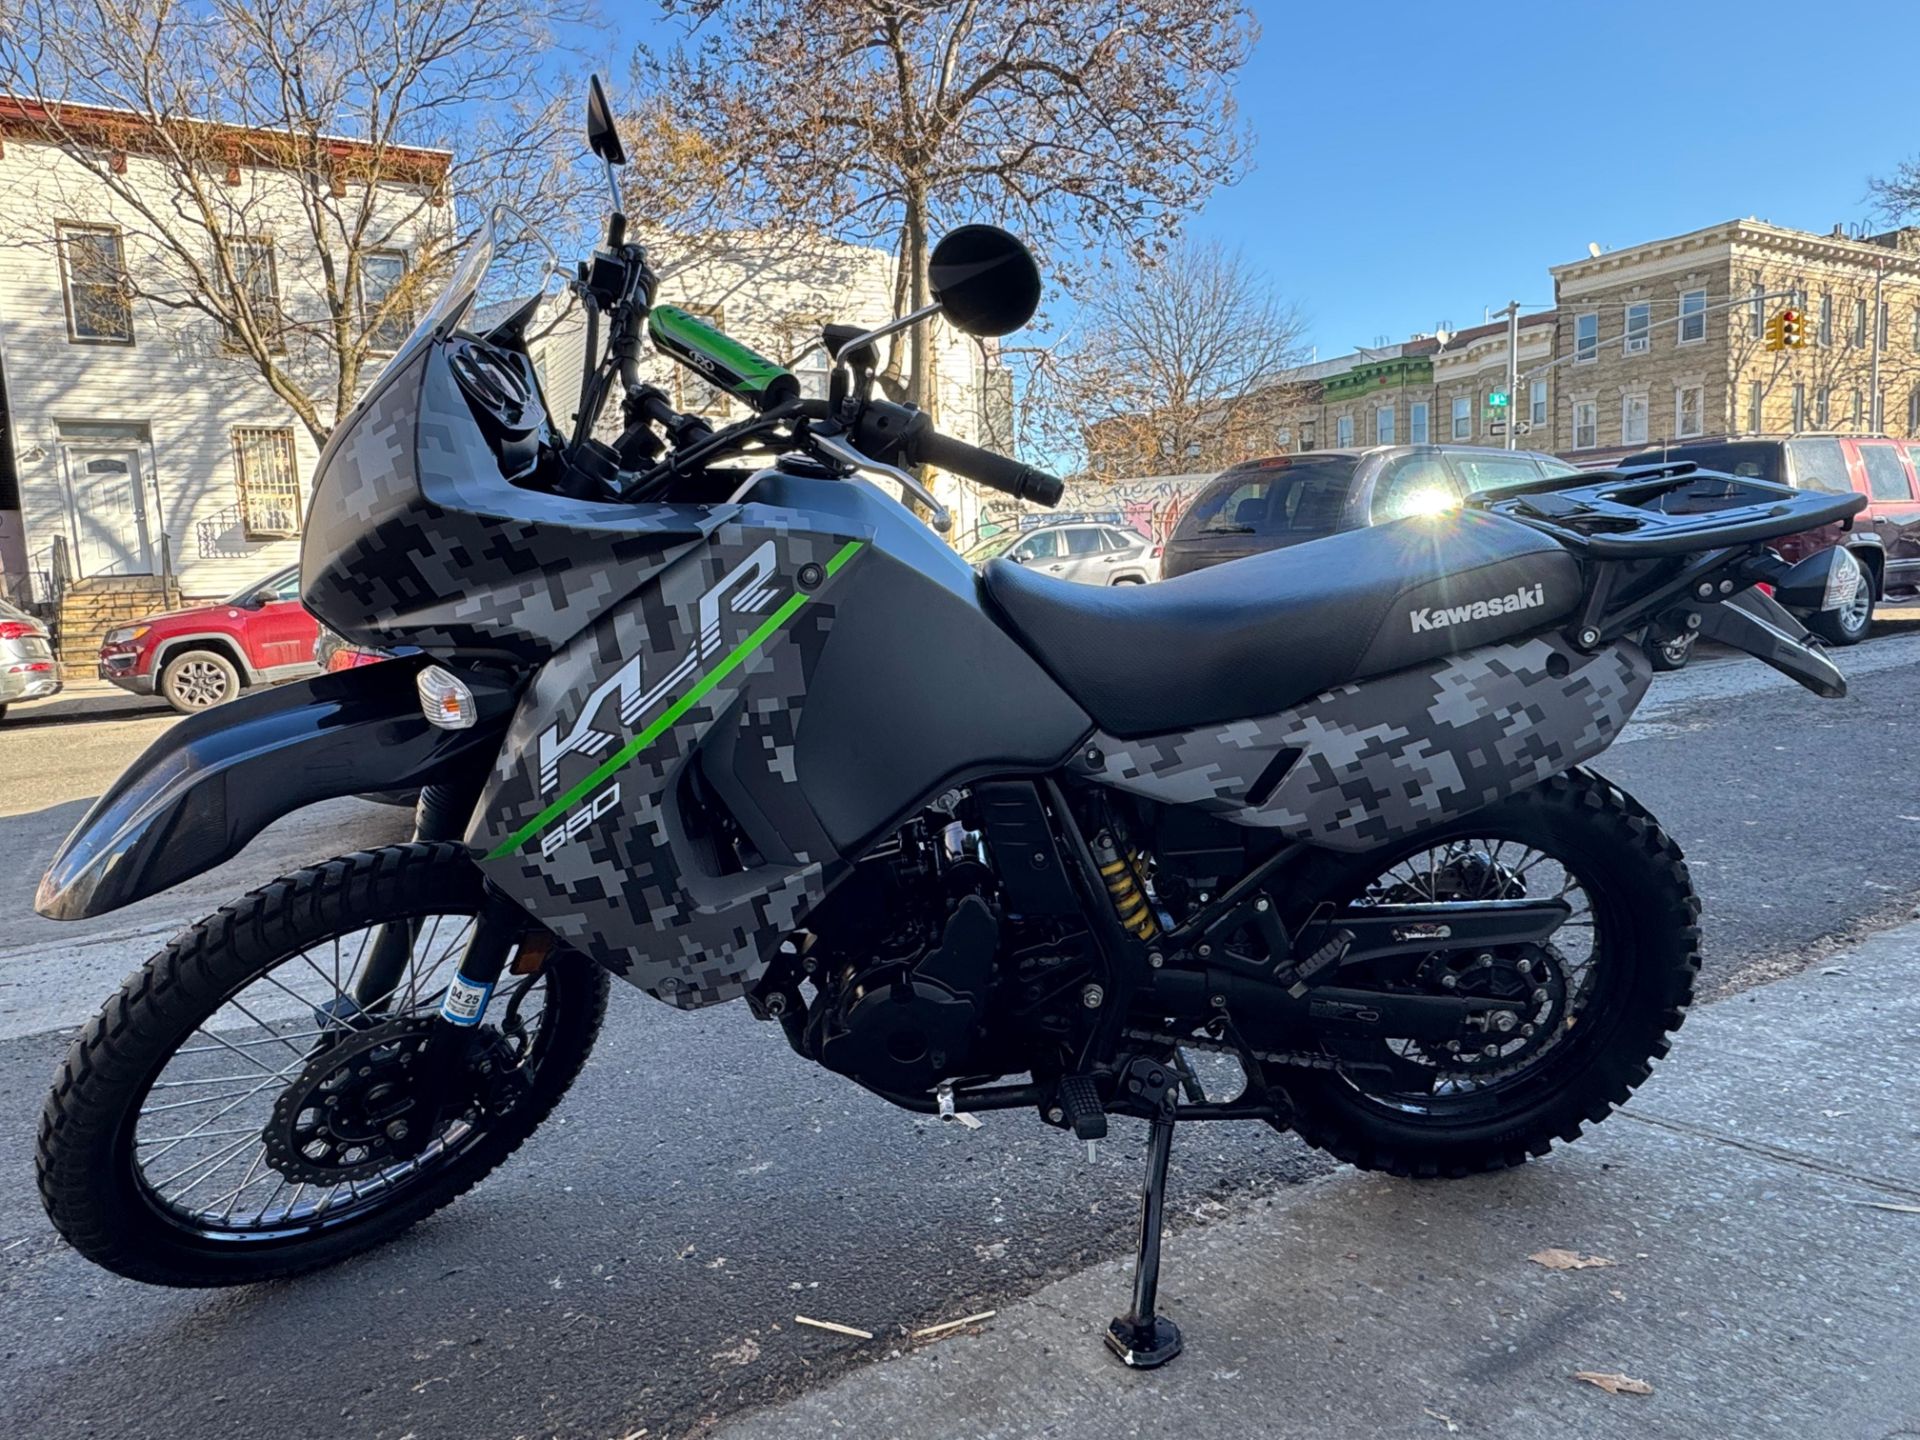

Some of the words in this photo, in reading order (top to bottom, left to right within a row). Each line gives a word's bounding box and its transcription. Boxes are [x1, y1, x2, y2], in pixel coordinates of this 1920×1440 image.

[1410, 583, 1544, 633] Kawasaki
[539, 540, 779, 795] KLR
[541, 782, 620, 857] 650
[464, 994, 480, 1005] 25
